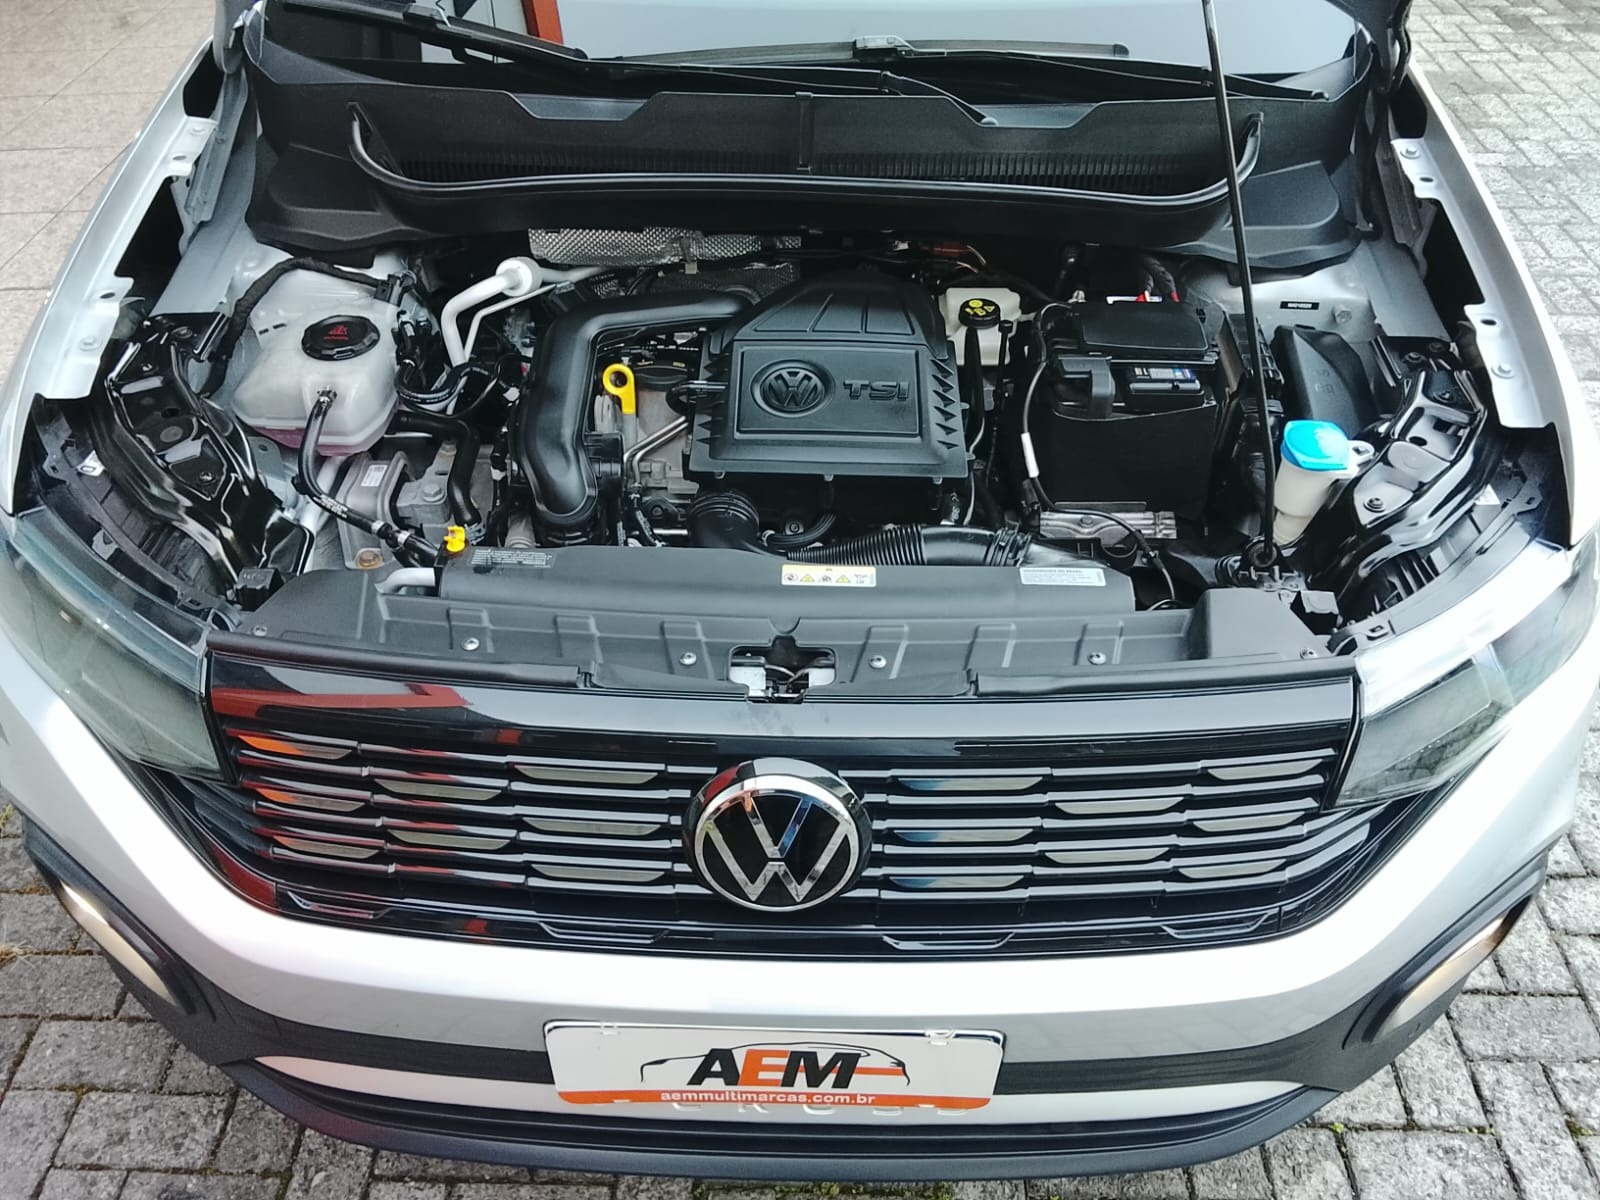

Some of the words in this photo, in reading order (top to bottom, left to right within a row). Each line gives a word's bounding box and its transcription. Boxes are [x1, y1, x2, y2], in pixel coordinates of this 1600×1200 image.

[843, 380, 910, 400] TSI
[686, 1048, 862, 1089] AEM
[661, 1090, 876, 1105] aemmultimarcas.com.br
